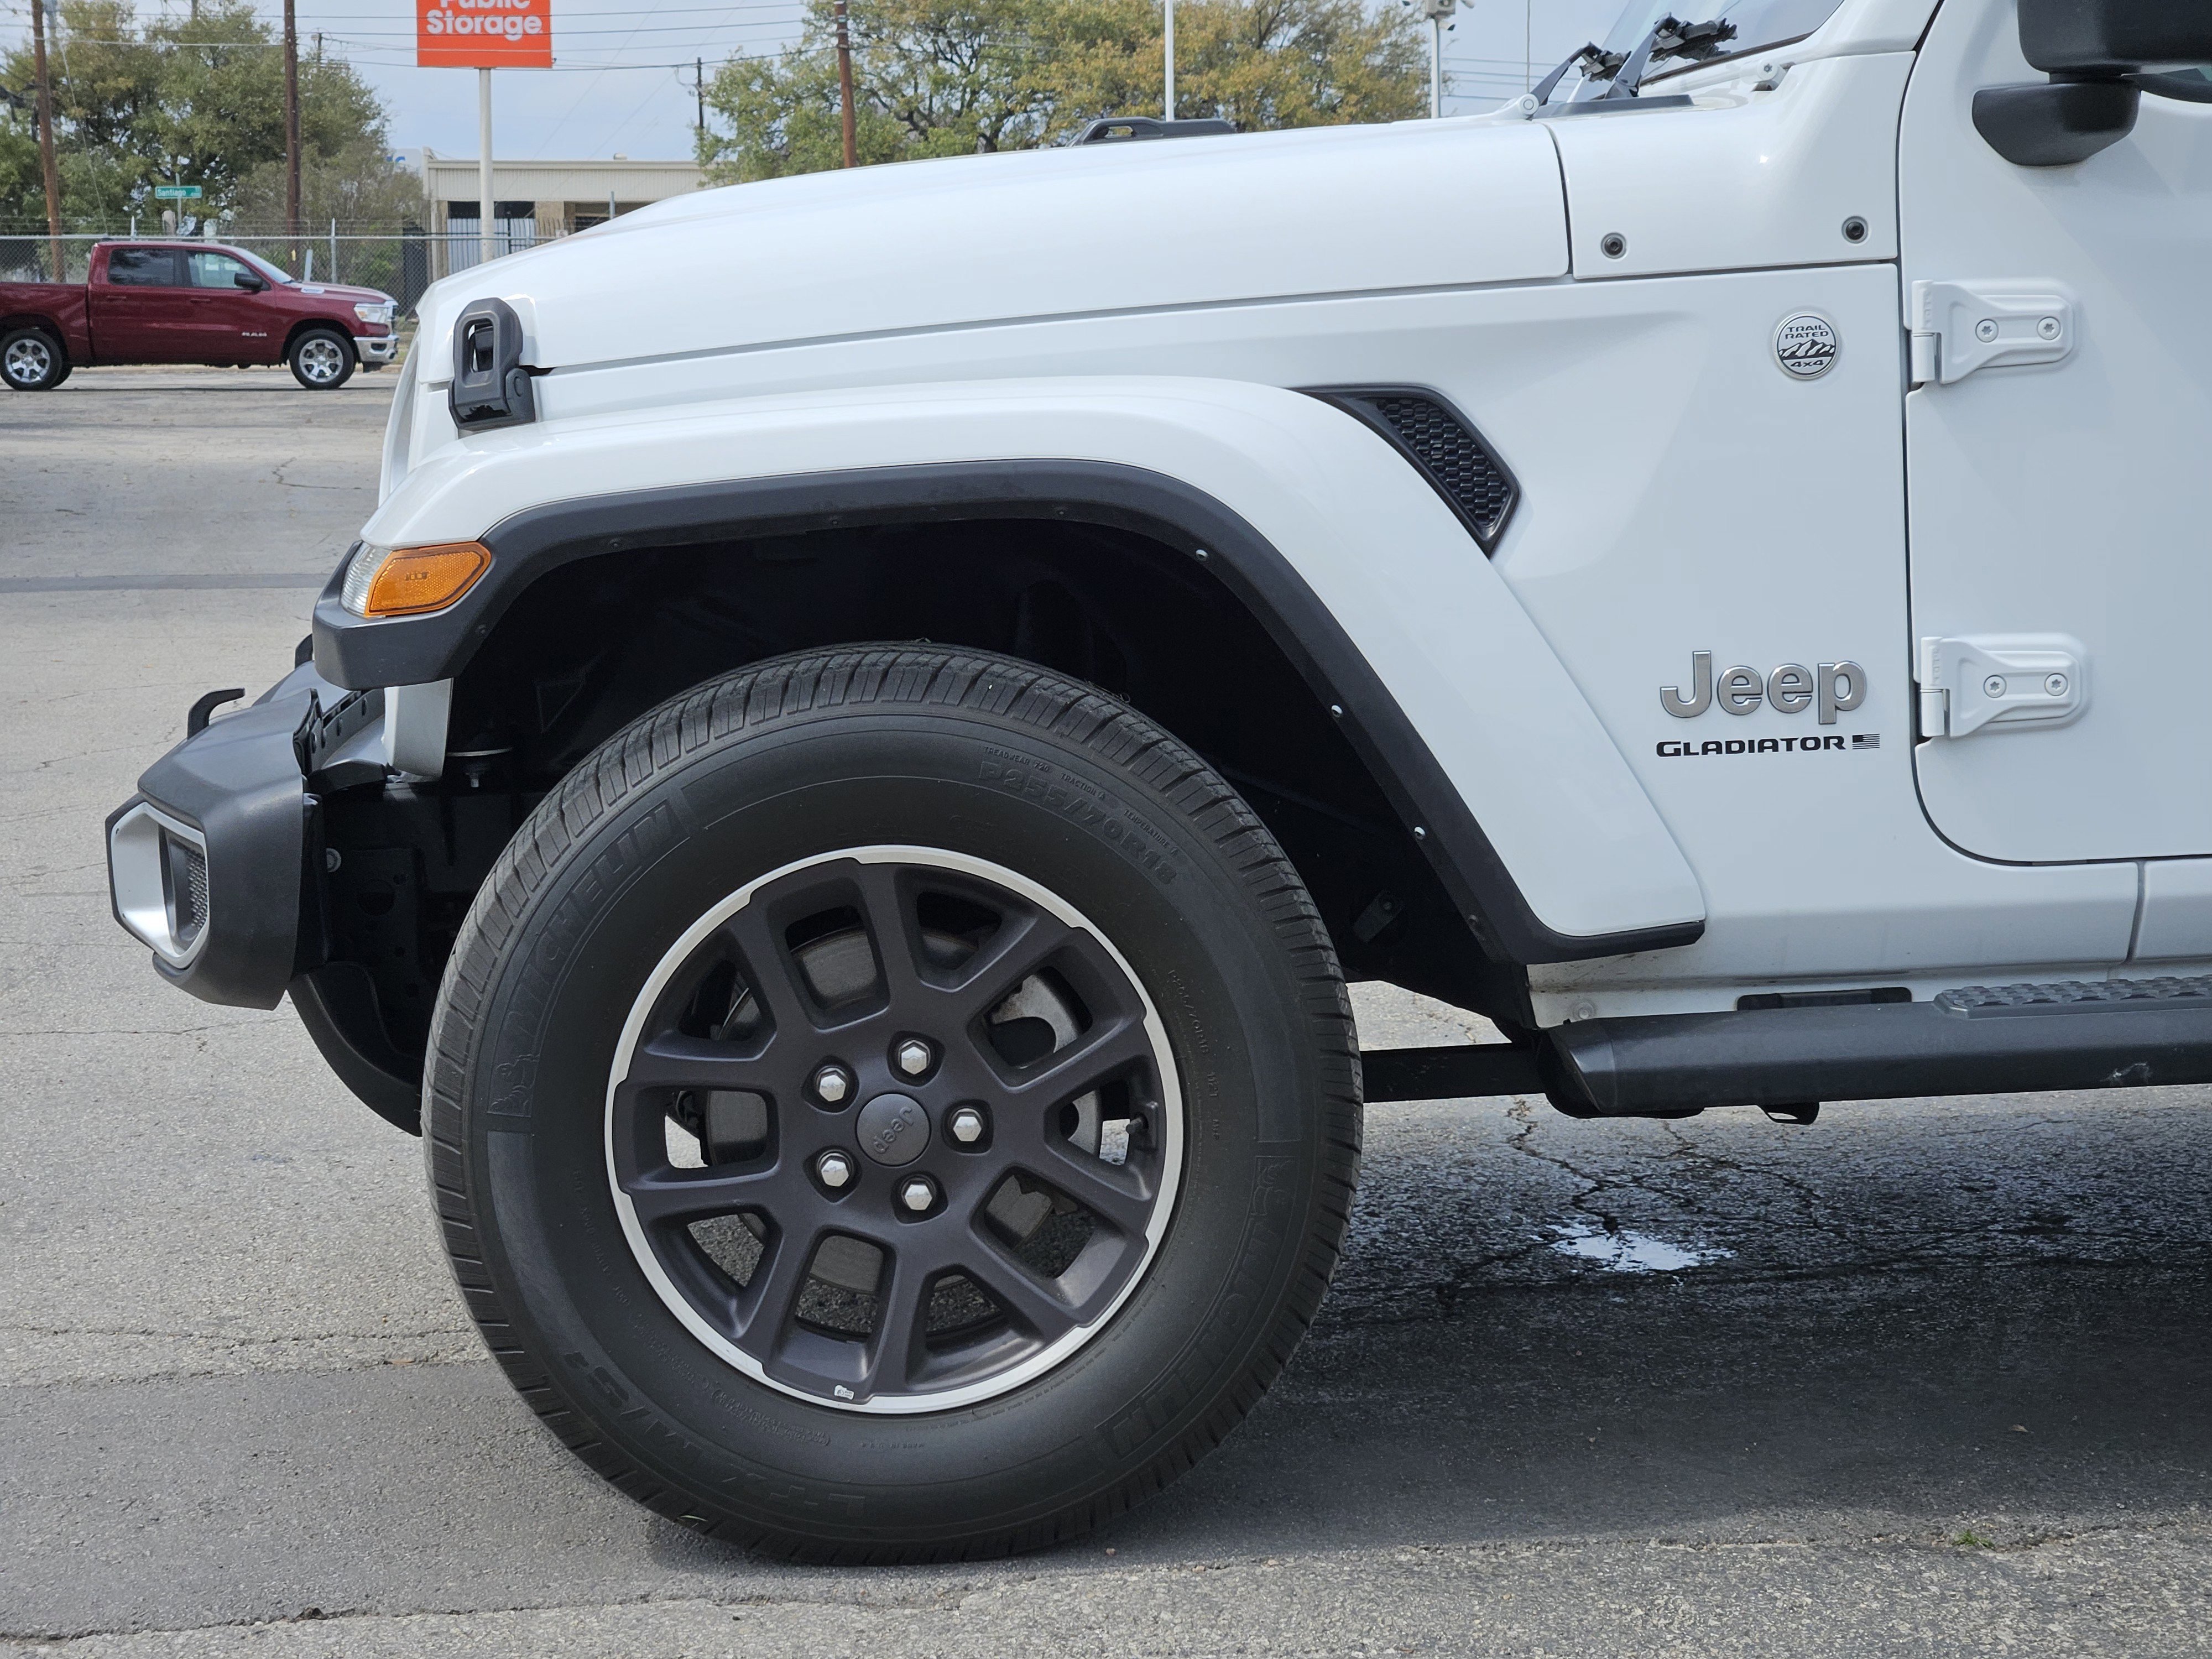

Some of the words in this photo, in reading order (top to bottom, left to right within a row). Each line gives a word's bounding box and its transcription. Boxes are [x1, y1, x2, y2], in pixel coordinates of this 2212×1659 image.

[426, 9, 542, 41] Storage
[1785, 331, 1829, 340] RATED
[1787, 325, 1826, 333] TRAIL
[1791, 359, 1824, 368] 4x4
[1660, 650, 1867, 725] Jeep
[1656, 735, 1846, 758] GLADIATOR
[984, 745, 1030, 766] TREADWEAR
[1061, 773, 1097, 797] TRACTION
[504, 803, 679, 1039] MICHELIN
[873, 1106, 914, 1154] Jeep
